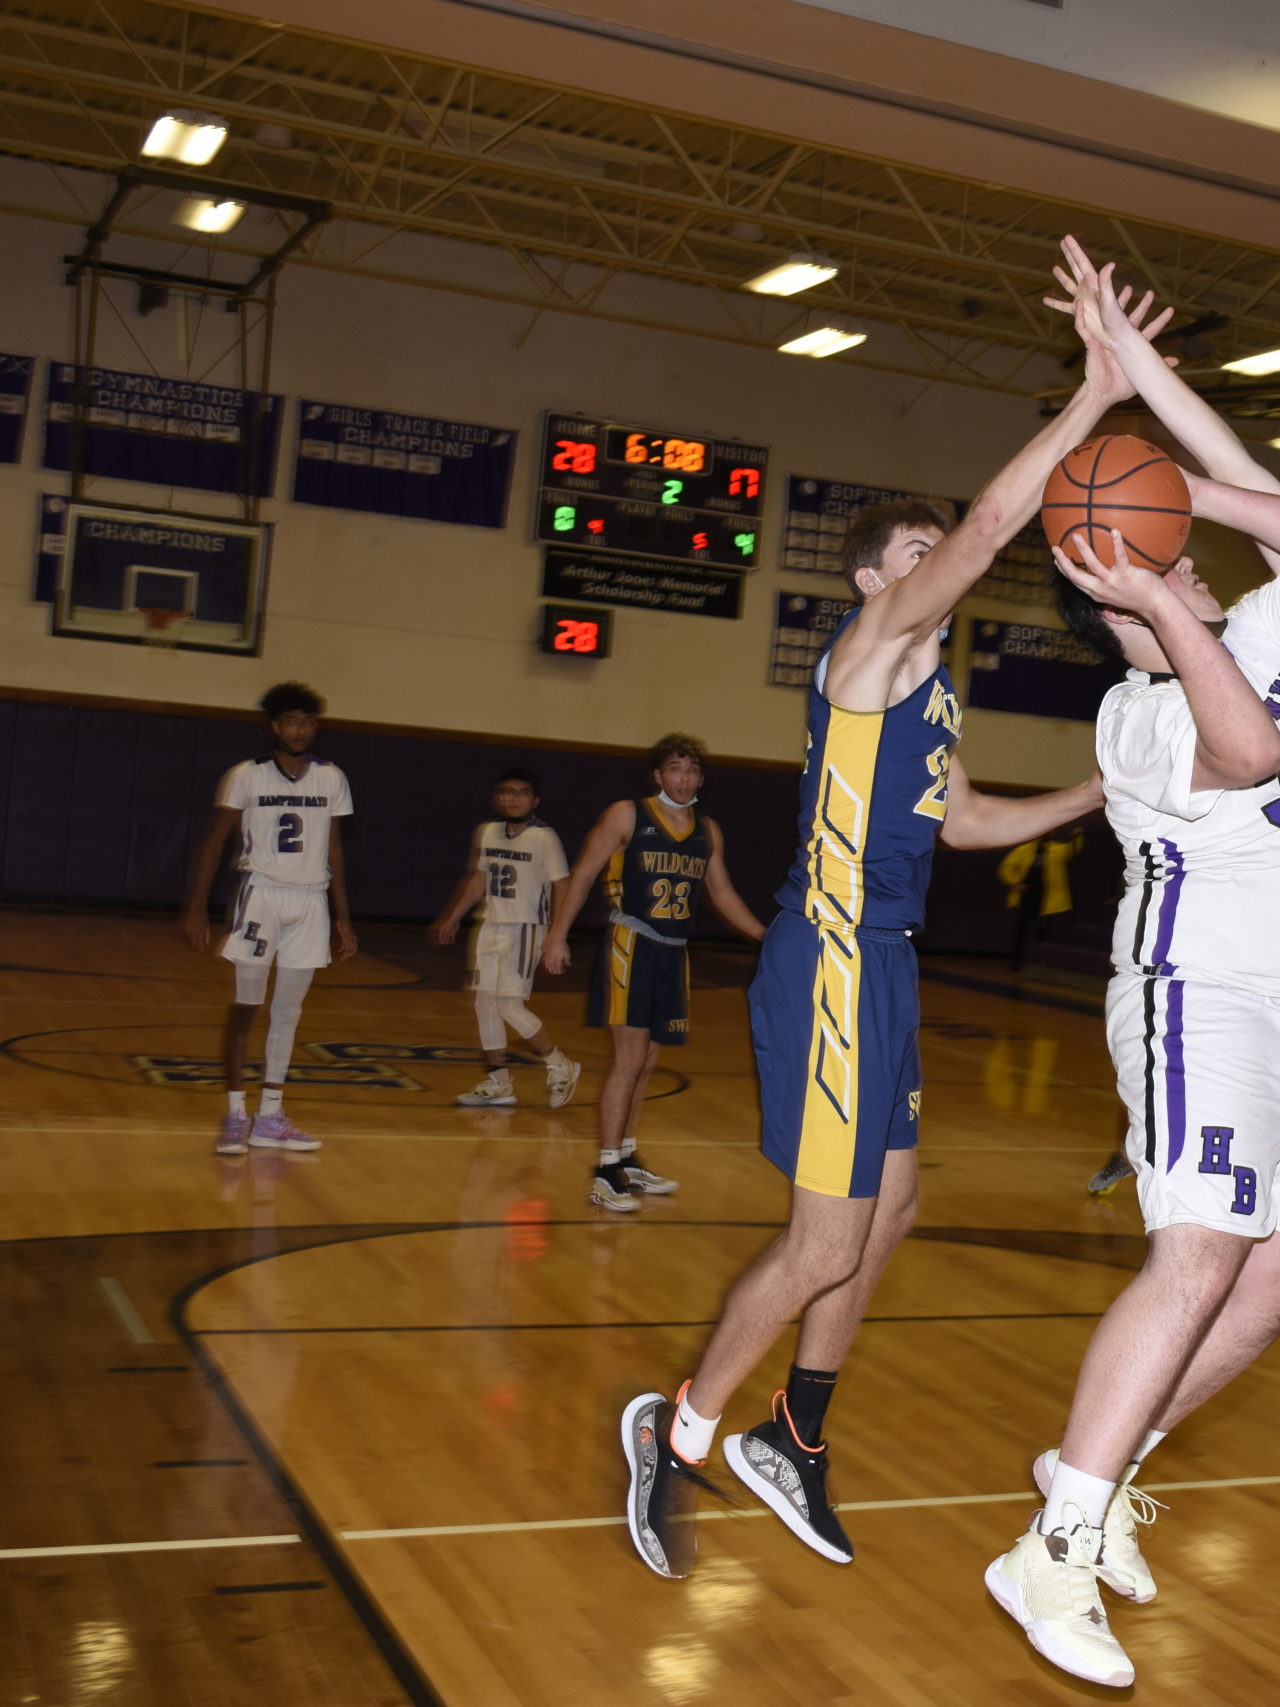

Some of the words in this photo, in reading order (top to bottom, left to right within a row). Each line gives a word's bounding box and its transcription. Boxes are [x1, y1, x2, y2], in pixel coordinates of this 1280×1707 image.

[88, 371, 244, 407] GYMNASTICS
[97, 391, 237, 424] CHAMPIONS
[331, 407, 373, 427] GIRLS
[384, 415, 431, 435] TRACK
[450, 424, 490, 443] FIELD
[557, 420, 598, 437] HOME
[343, 427, 474, 458] CHAMPIONS
[552, 440, 597, 473] 28
[716, 445, 767, 464] VISITOR
[662, 480, 683, 504] 2
[831, 484, 911, 504] SOFTB
[87, 520, 226, 552] CHAMPIONS
[566, 564, 613, 582] Arthur
[616, 570, 656, 587] Jones
[661, 577, 727, 596] Memorial
[585, 582, 666, 605] Scholarship
[669, 593, 707, 608] Fund
[554, 619, 599, 653] 28
[278, 812, 303, 853] 2
[489, 862, 518, 899] 12
[643, 850, 707, 880] WILDCATS
[650, 878, 691, 920] 23
